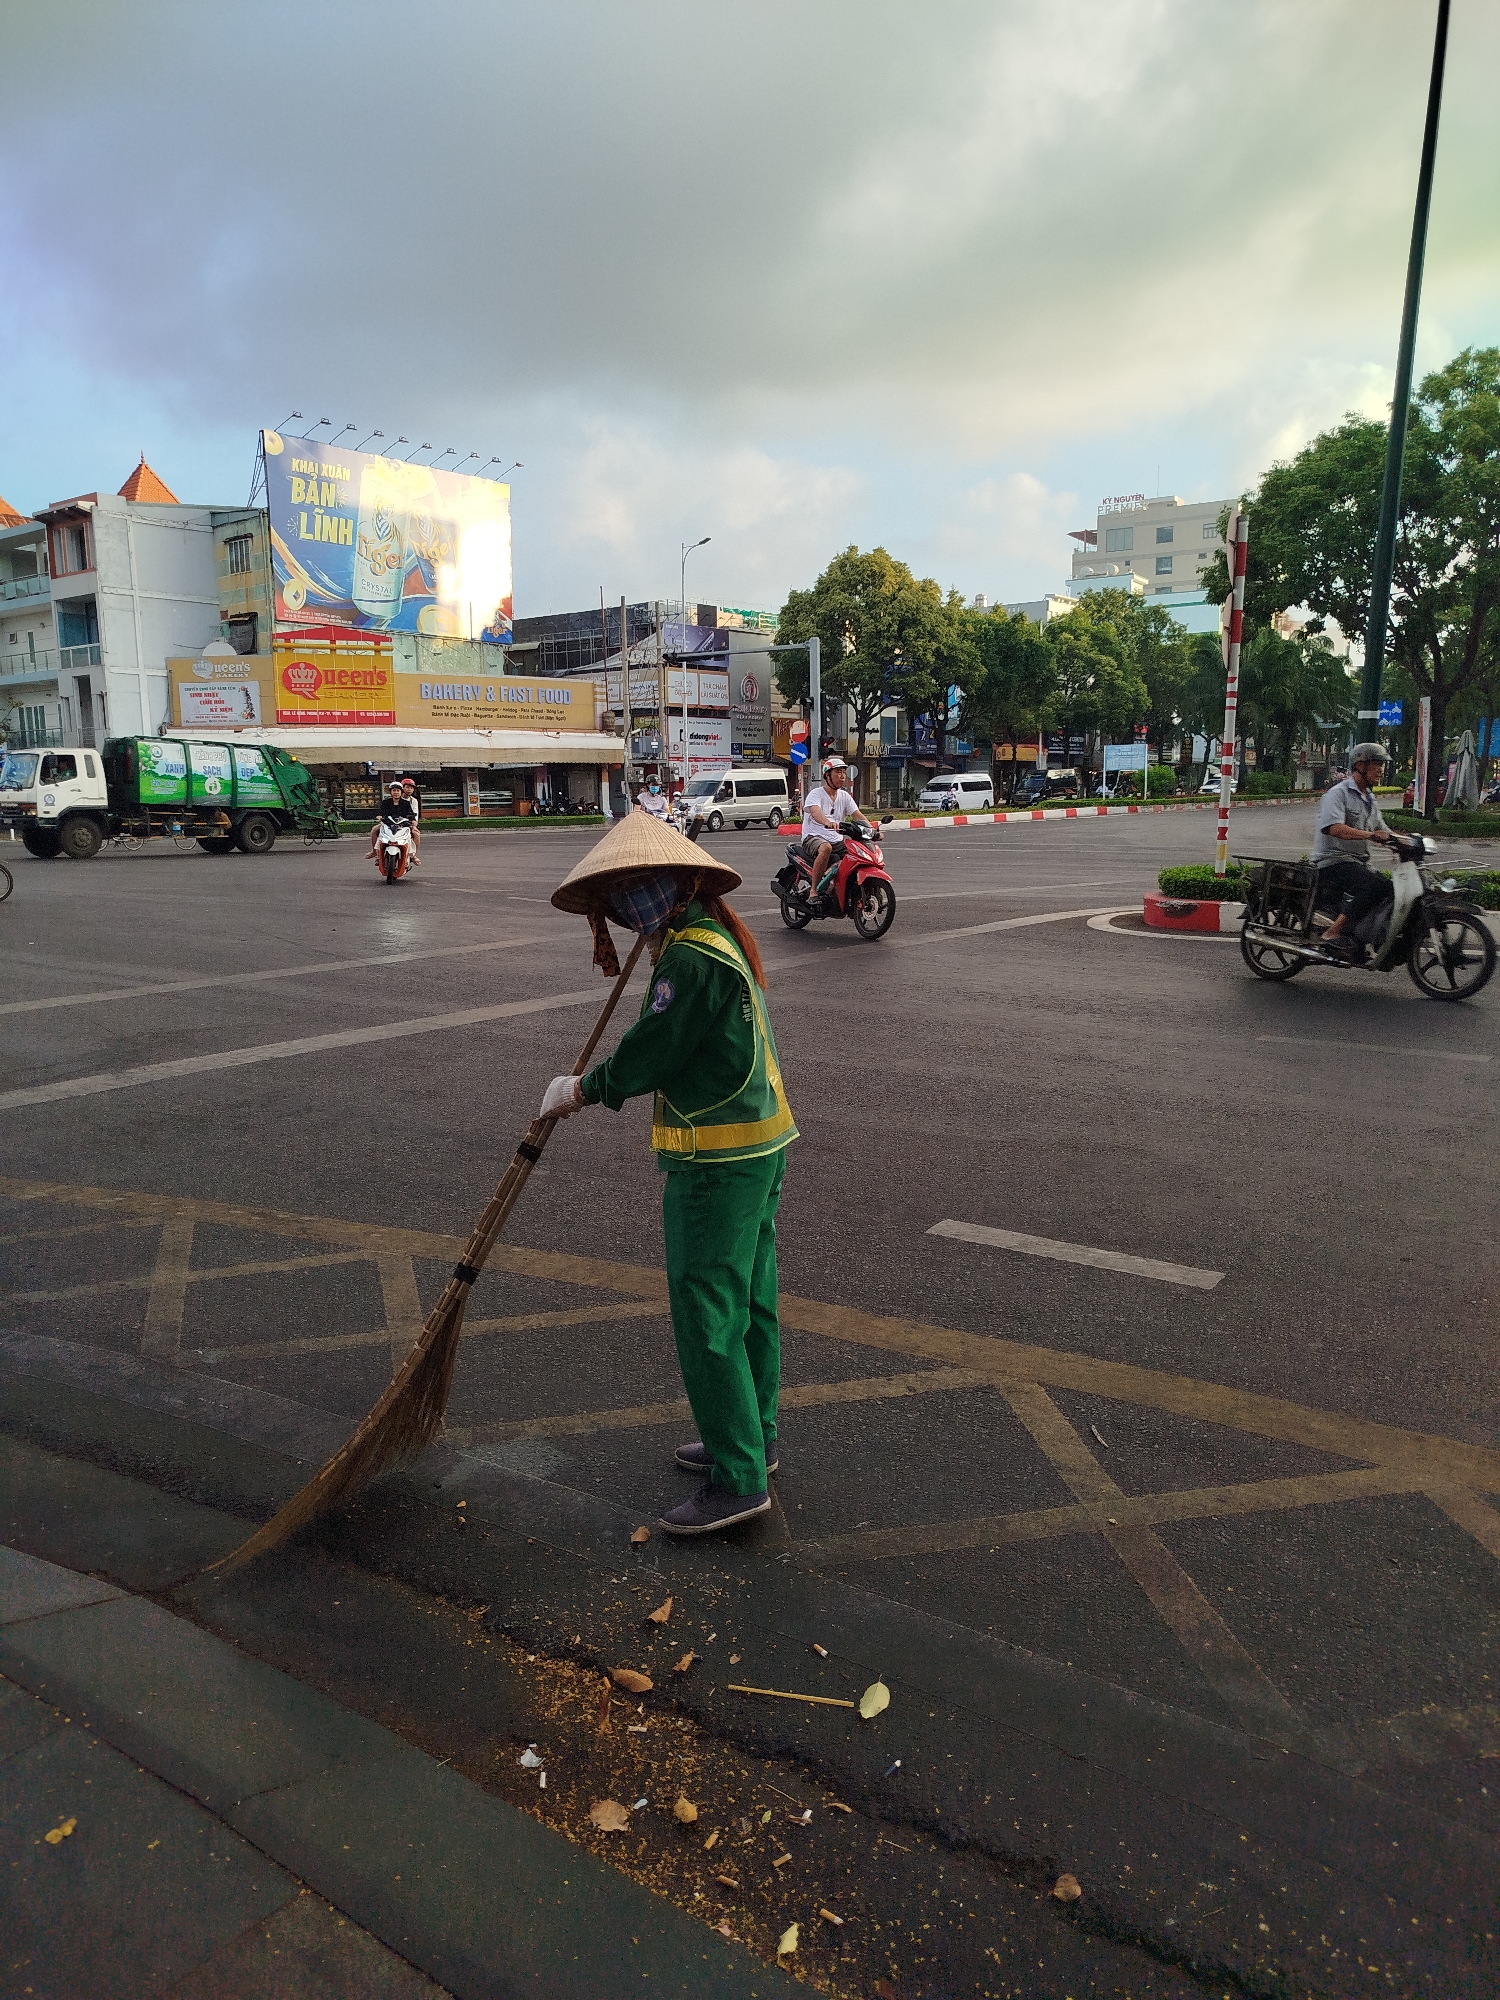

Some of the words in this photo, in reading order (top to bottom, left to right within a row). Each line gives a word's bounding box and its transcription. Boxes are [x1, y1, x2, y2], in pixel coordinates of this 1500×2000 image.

[321, 464, 351, 481] XUÂN
[290, 472, 336, 508] BẢN
[299, 508, 354, 545] LĨNH
[357, 532, 405, 577] Tiger
[361, 578, 393, 595] CRYSTAL
[420, 682, 483, 701] BAKERY
[486, 685, 496, 702] &
[500, 685, 534, 703] FAST
[538, 688, 572, 705] FOOD
[164, 762, 185, 774] XANH
[240, 767, 255, 778] ĐẸP
